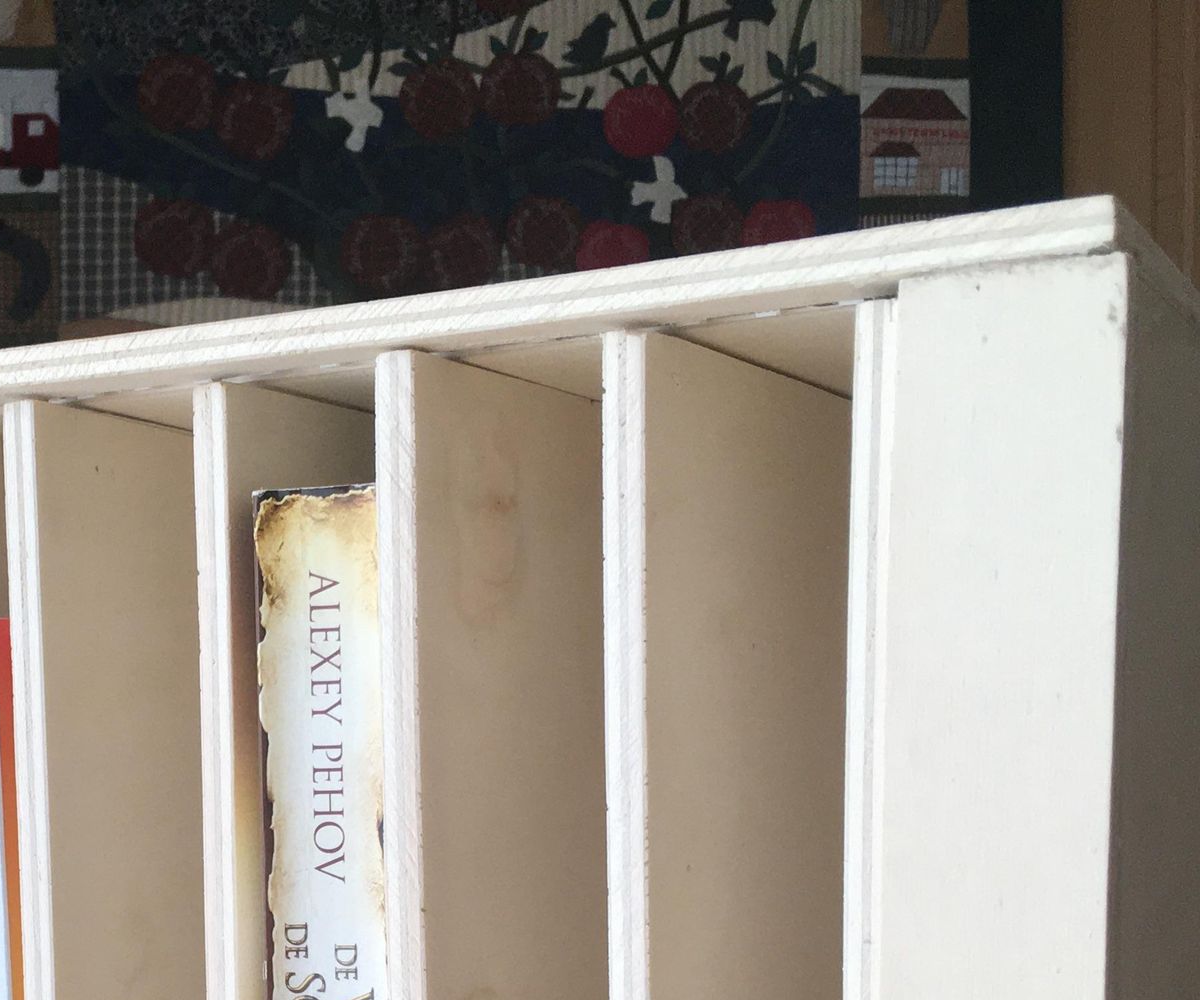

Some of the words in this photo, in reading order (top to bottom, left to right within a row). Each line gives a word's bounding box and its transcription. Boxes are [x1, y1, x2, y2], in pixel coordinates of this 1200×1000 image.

[308, 569, 343, 726] ALEXEY
[311, 742, 346, 884] PEHOV
[284, 922, 309, 960] DE
[334, 943, 358, 981] DE
